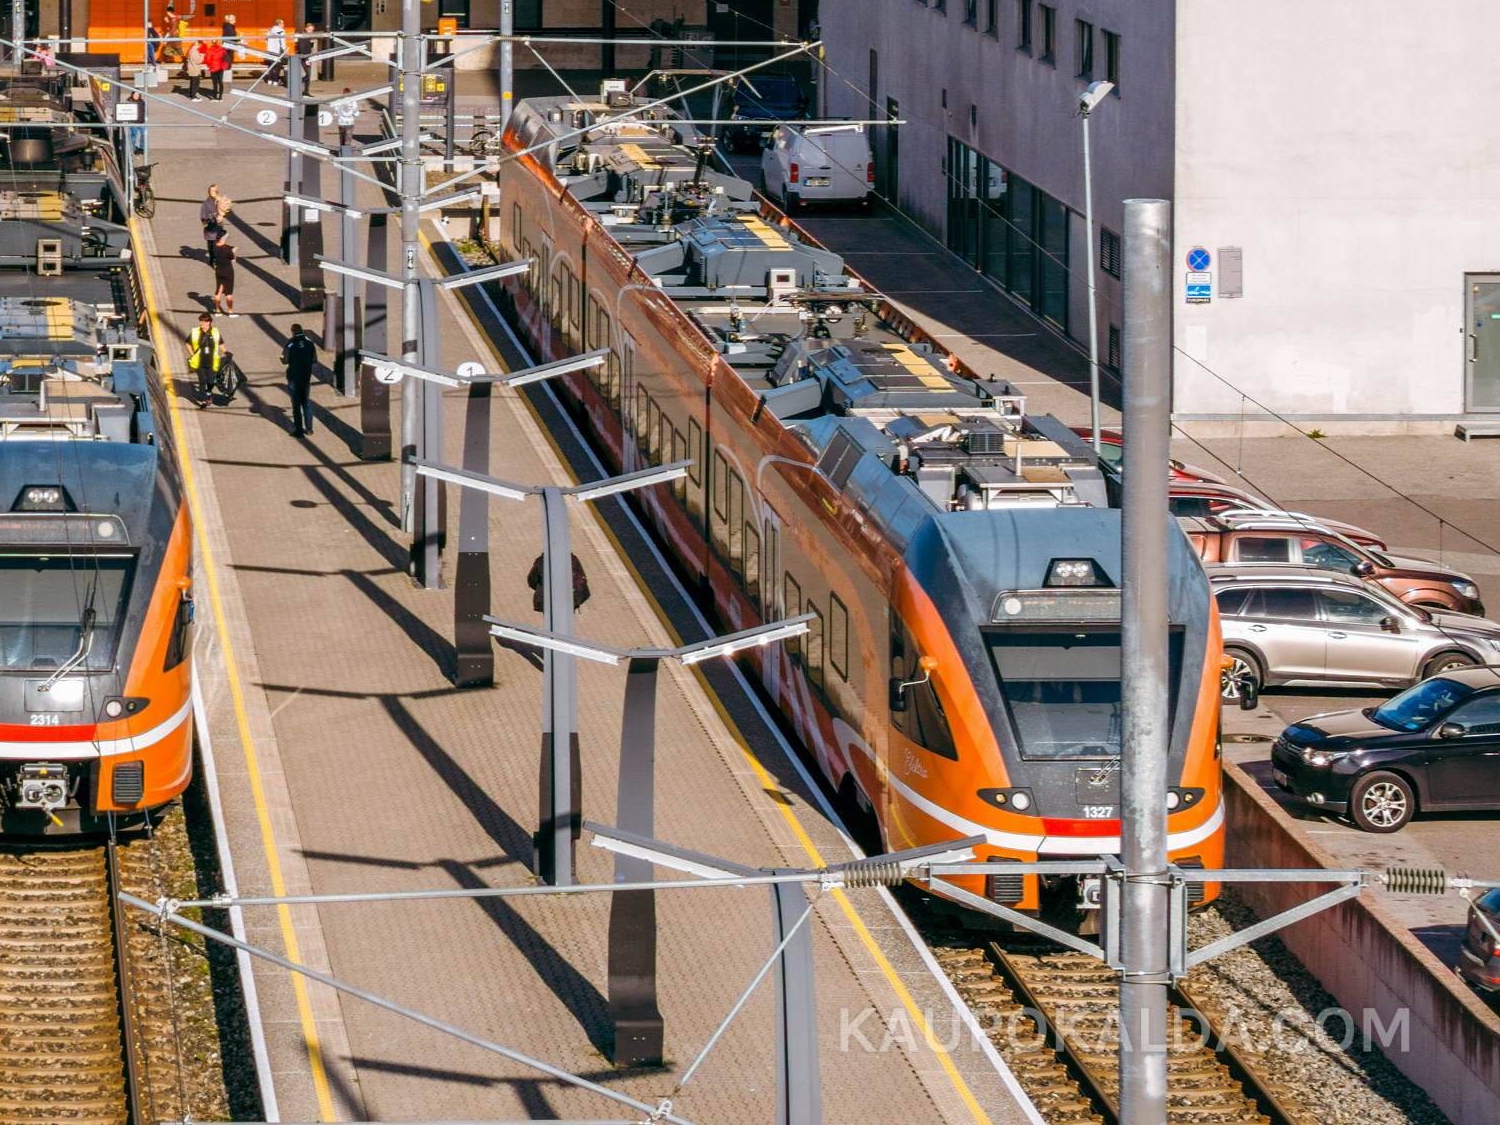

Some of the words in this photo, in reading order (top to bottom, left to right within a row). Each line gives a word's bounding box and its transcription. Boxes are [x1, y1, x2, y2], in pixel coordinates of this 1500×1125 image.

[262, 113, 271, 124] 2
[319, 113, 325, 125] 1
[30, 714, 59, 725] 2314
[1083, 806, 1114, 818] 1327
